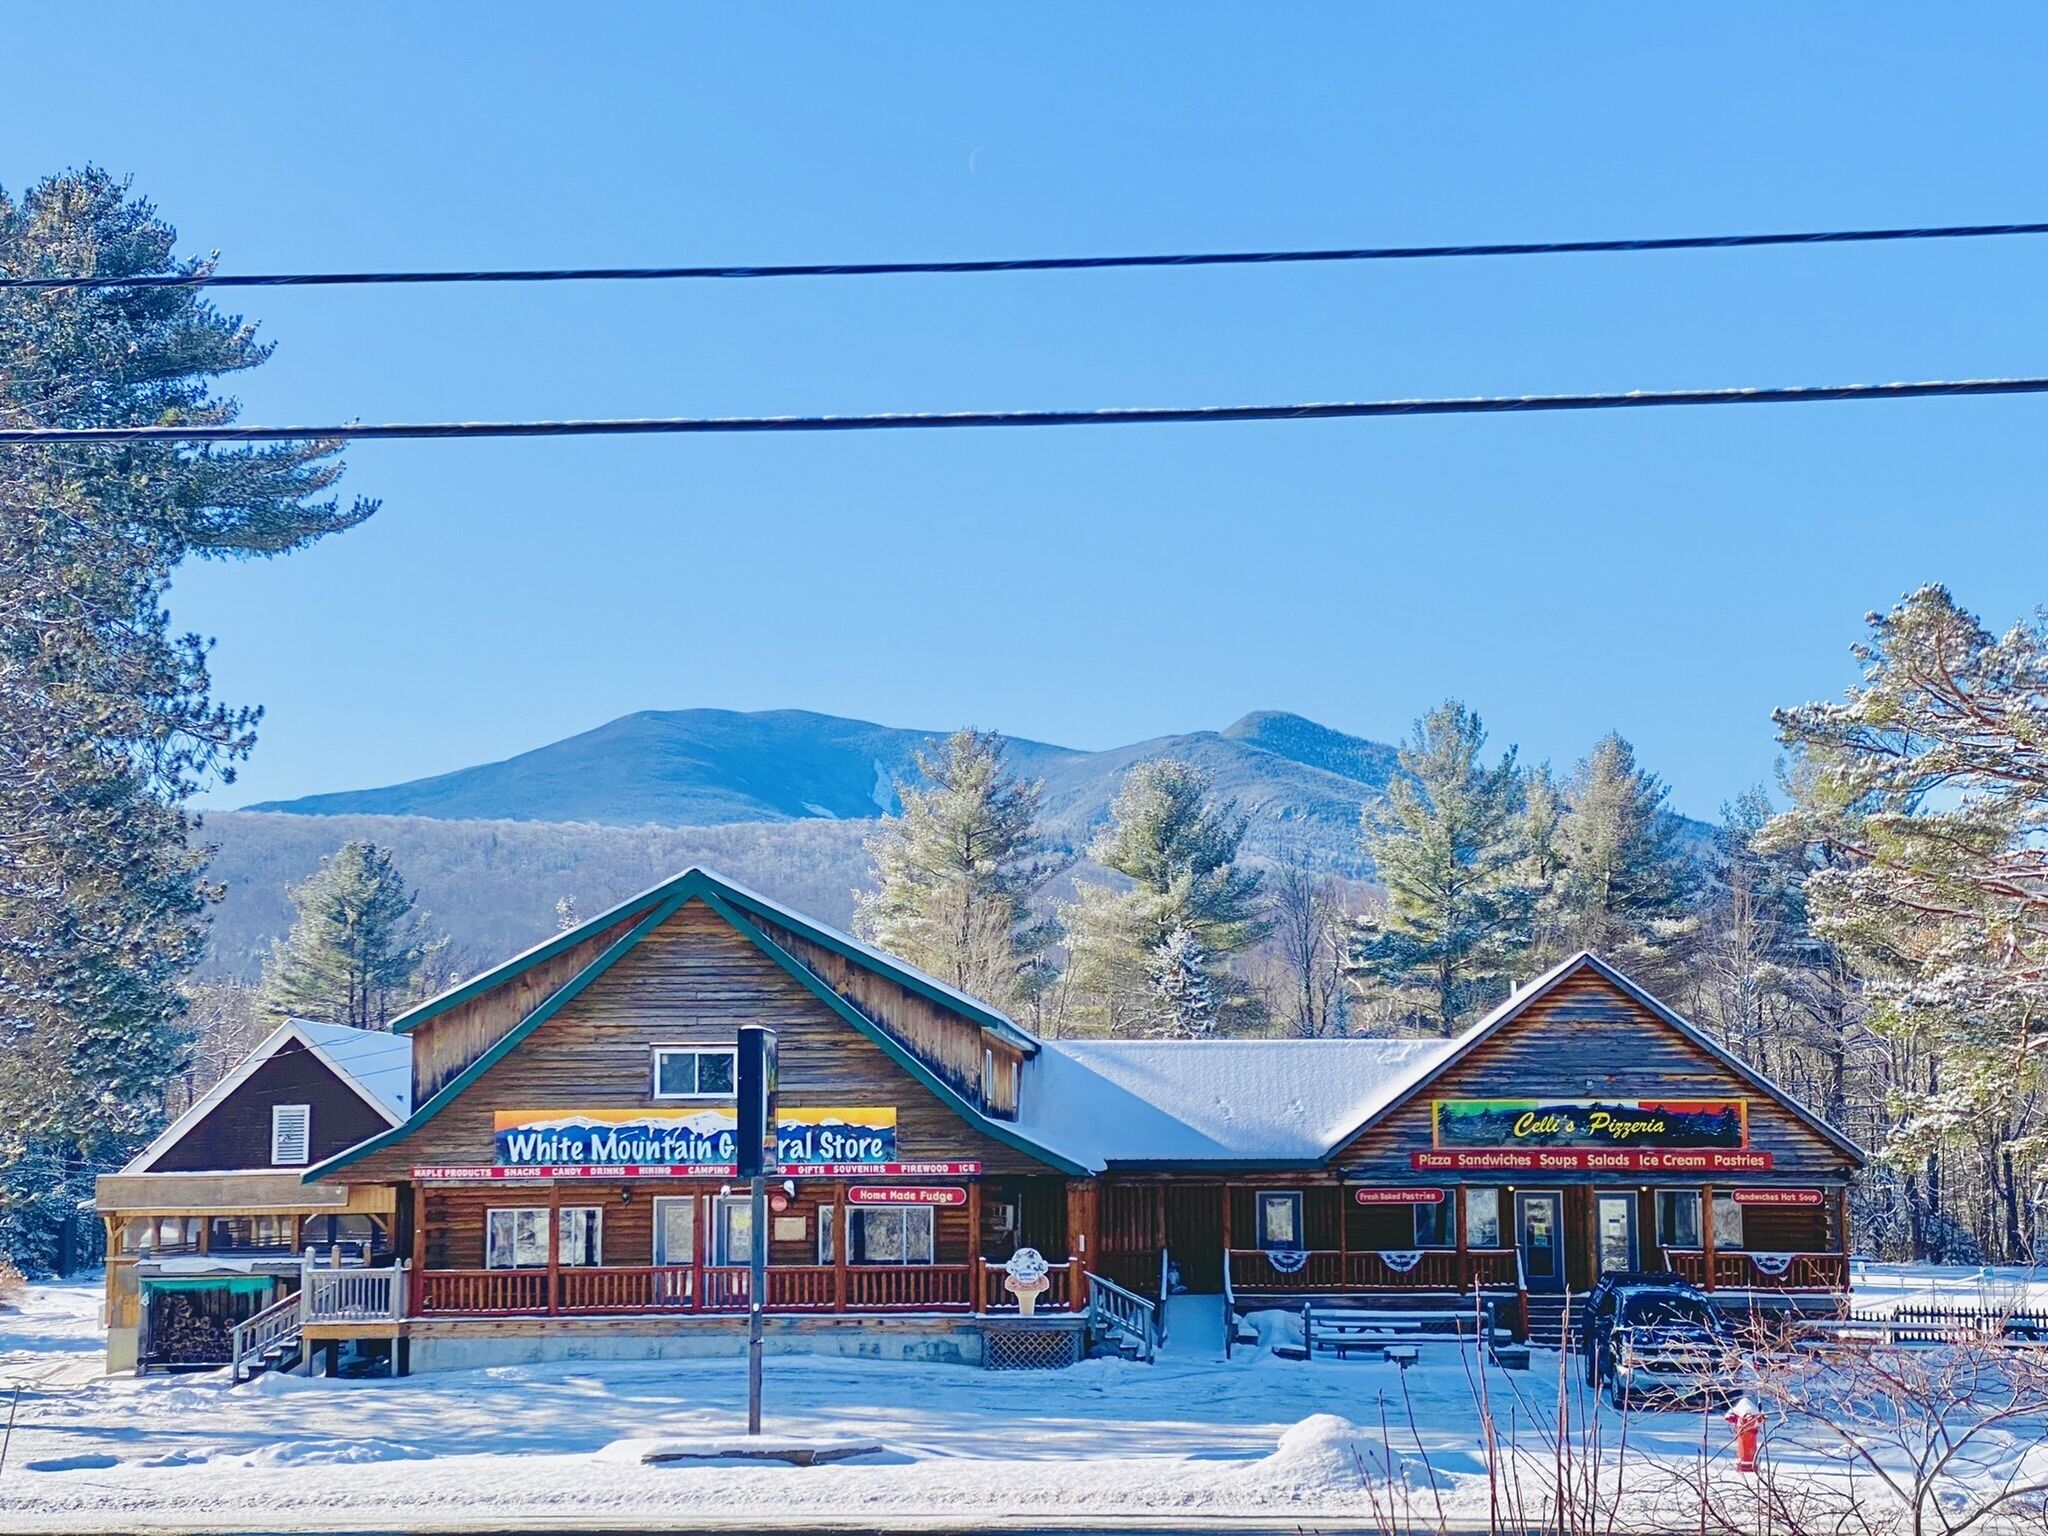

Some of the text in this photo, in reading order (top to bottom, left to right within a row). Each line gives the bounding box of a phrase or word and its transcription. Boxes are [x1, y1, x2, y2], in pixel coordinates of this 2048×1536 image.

[1513, 1111, 1666, 1138] Celli's Pizzeria
[507, 1131, 883, 1163] White Mountain Gral Store
[1419, 1154, 1765, 1168] Pizza Sandwiches Soups Salads Ice Cream Pastries
[414, 1168, 443, 1177] MAPLE
[445, 1167, 492, 1177] PRODUCTS
[504, 1167, 541, 1176] SNACKS
[552, 1167, 582, 1176] CANDY
[590, 1166, 626, 1175] DRINKS
[639, 1166, 672, 1175] HIKING
[688, 1166, 730, 1175] CAMPING
[798, 1166, 825, 1174] GIFTS
[833, 1165, 886, 1174] SOUVENIRS
[901, 1164, 949, 1173] FIREWOOD
[959, 1164, 975, 1172] ICE
[860, 1190, 953, 1203] Home Made Fudge
[1402, 1192, 1436, 1200] Pastries
[1781, 1193, 1796, 1201] Hot
[1799, 1193, 1818, 1203] Soup
